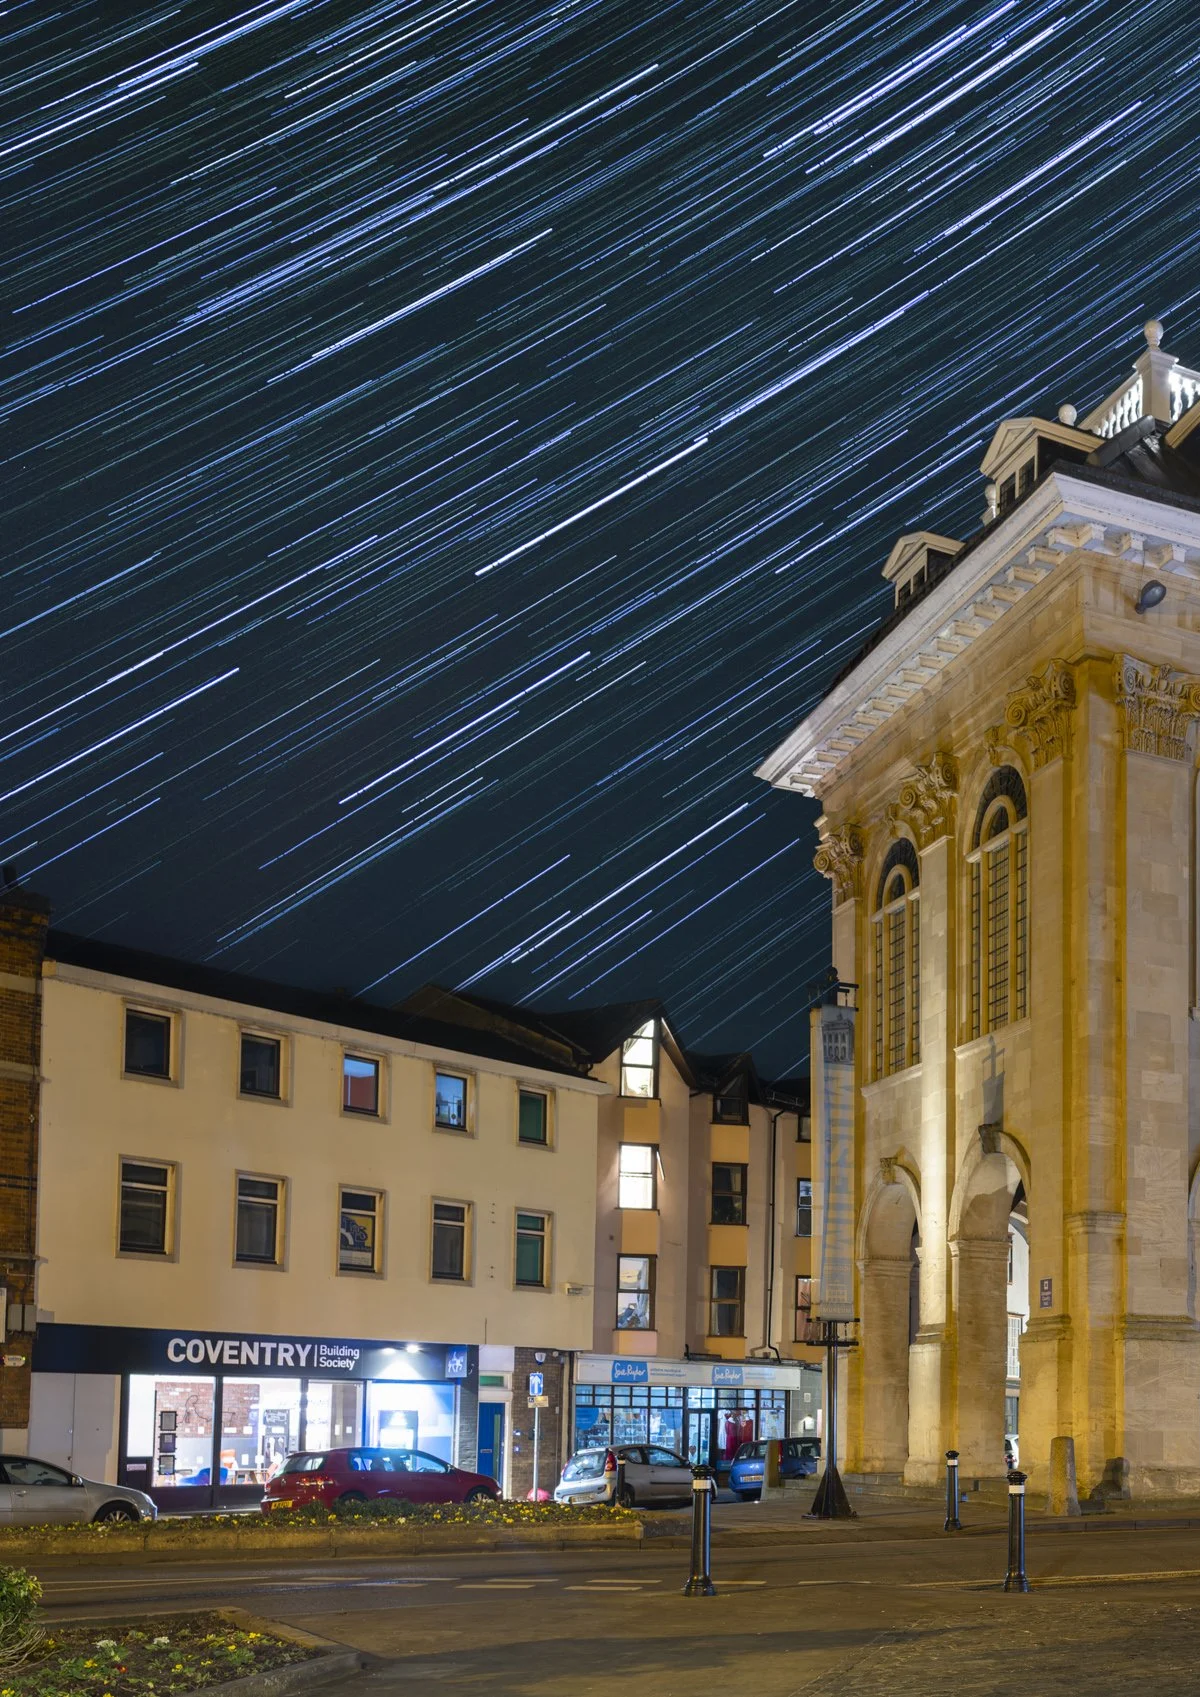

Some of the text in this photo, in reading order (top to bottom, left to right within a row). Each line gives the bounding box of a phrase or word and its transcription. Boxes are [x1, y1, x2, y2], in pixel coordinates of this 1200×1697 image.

[167, 1338, 312, 1367] COVENTRY
[320, 1345, 360, 1359] Building
[319, 1357, 356, 1370] Society
[615, 1363, 646, 1380] Sue Ryder
[715, 1367, 742, 1384] Sue Ryder
